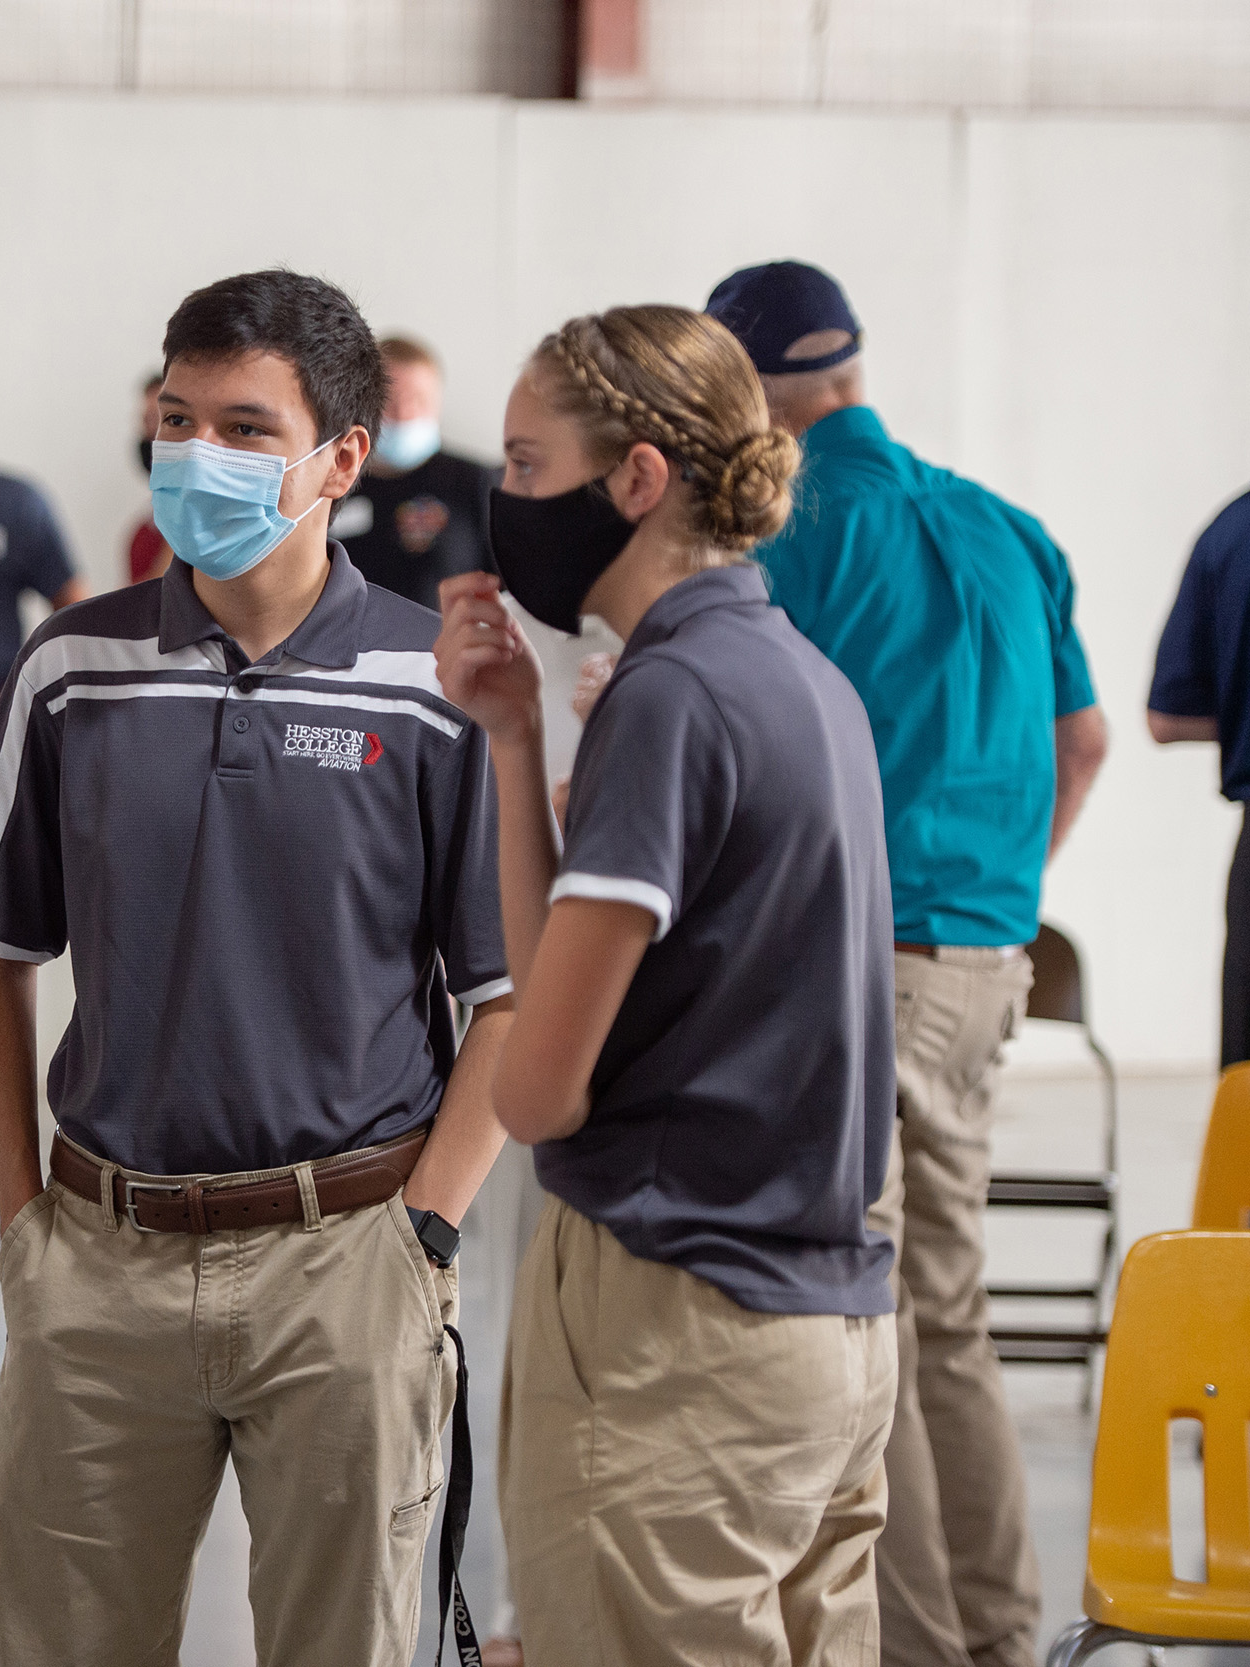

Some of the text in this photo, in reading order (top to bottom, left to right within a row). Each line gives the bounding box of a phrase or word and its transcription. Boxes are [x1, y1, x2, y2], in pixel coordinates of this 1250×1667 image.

[285, 724, 365, 745] HESSTON
[285, 737, 362, 757] COLLEGE
[318, 758, 361, 772] AVIATION
